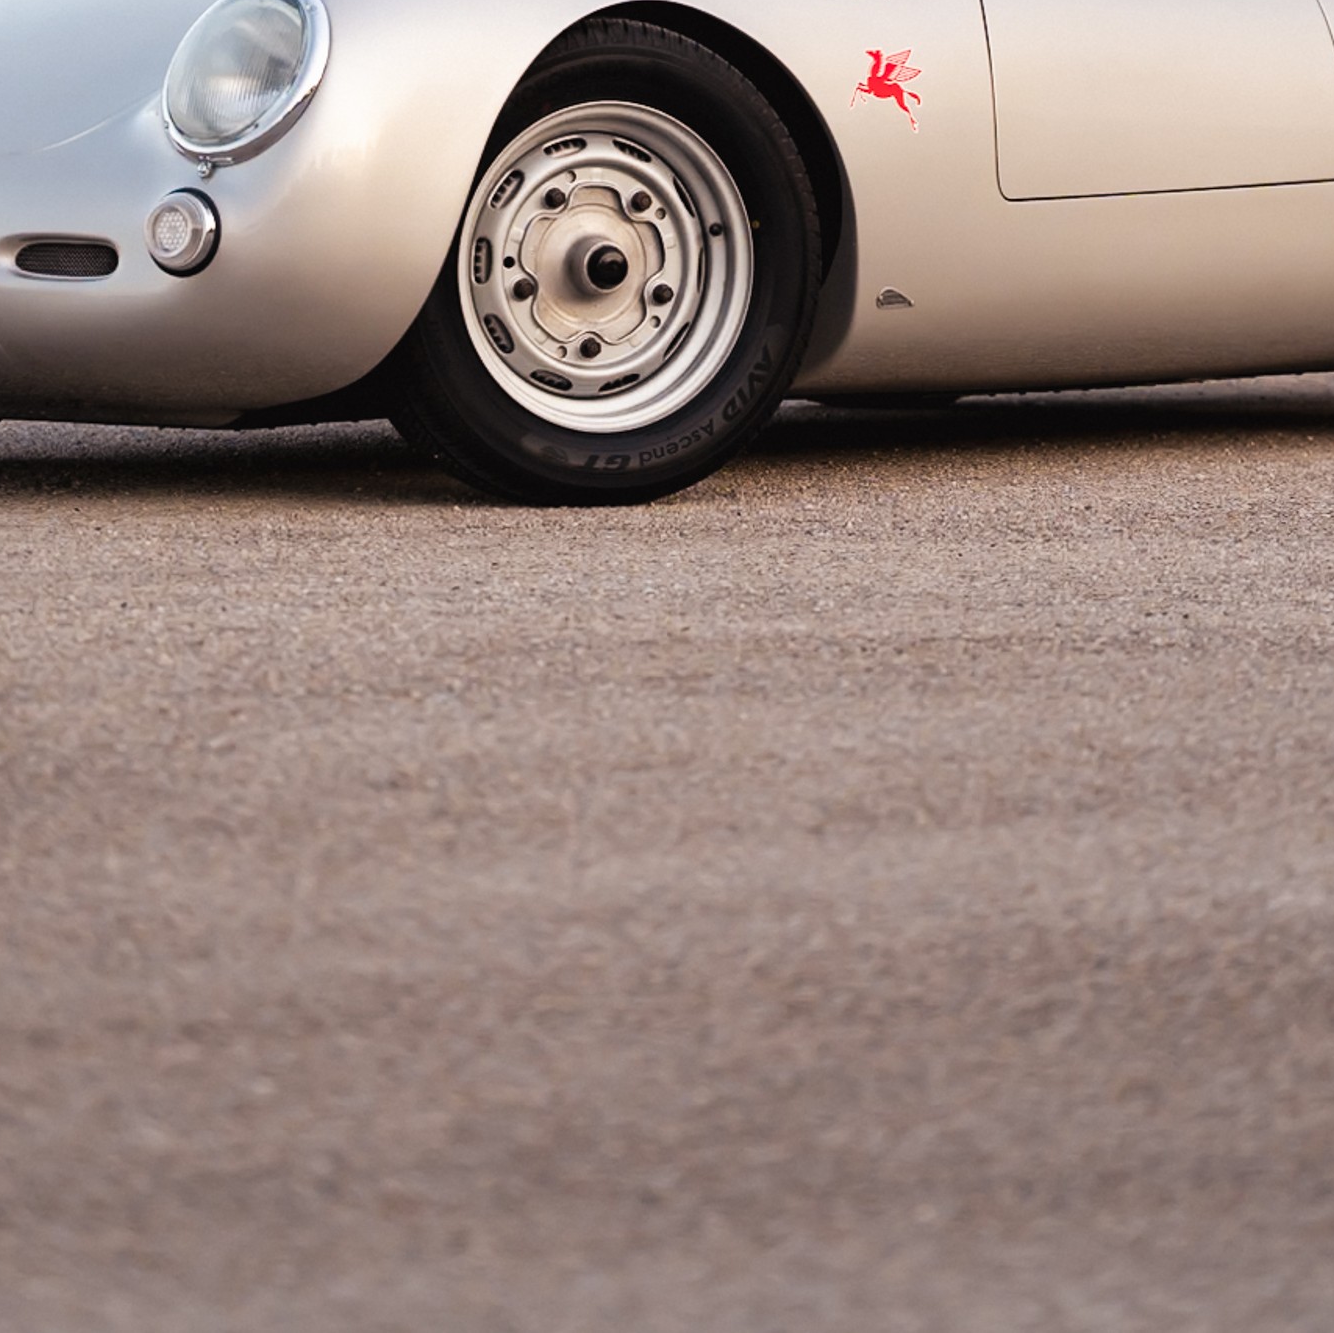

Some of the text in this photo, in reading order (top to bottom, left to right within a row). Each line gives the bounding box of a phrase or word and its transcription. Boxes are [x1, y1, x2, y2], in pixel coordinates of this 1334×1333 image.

[583, 345, 773, 471] AVID Ascend GT
